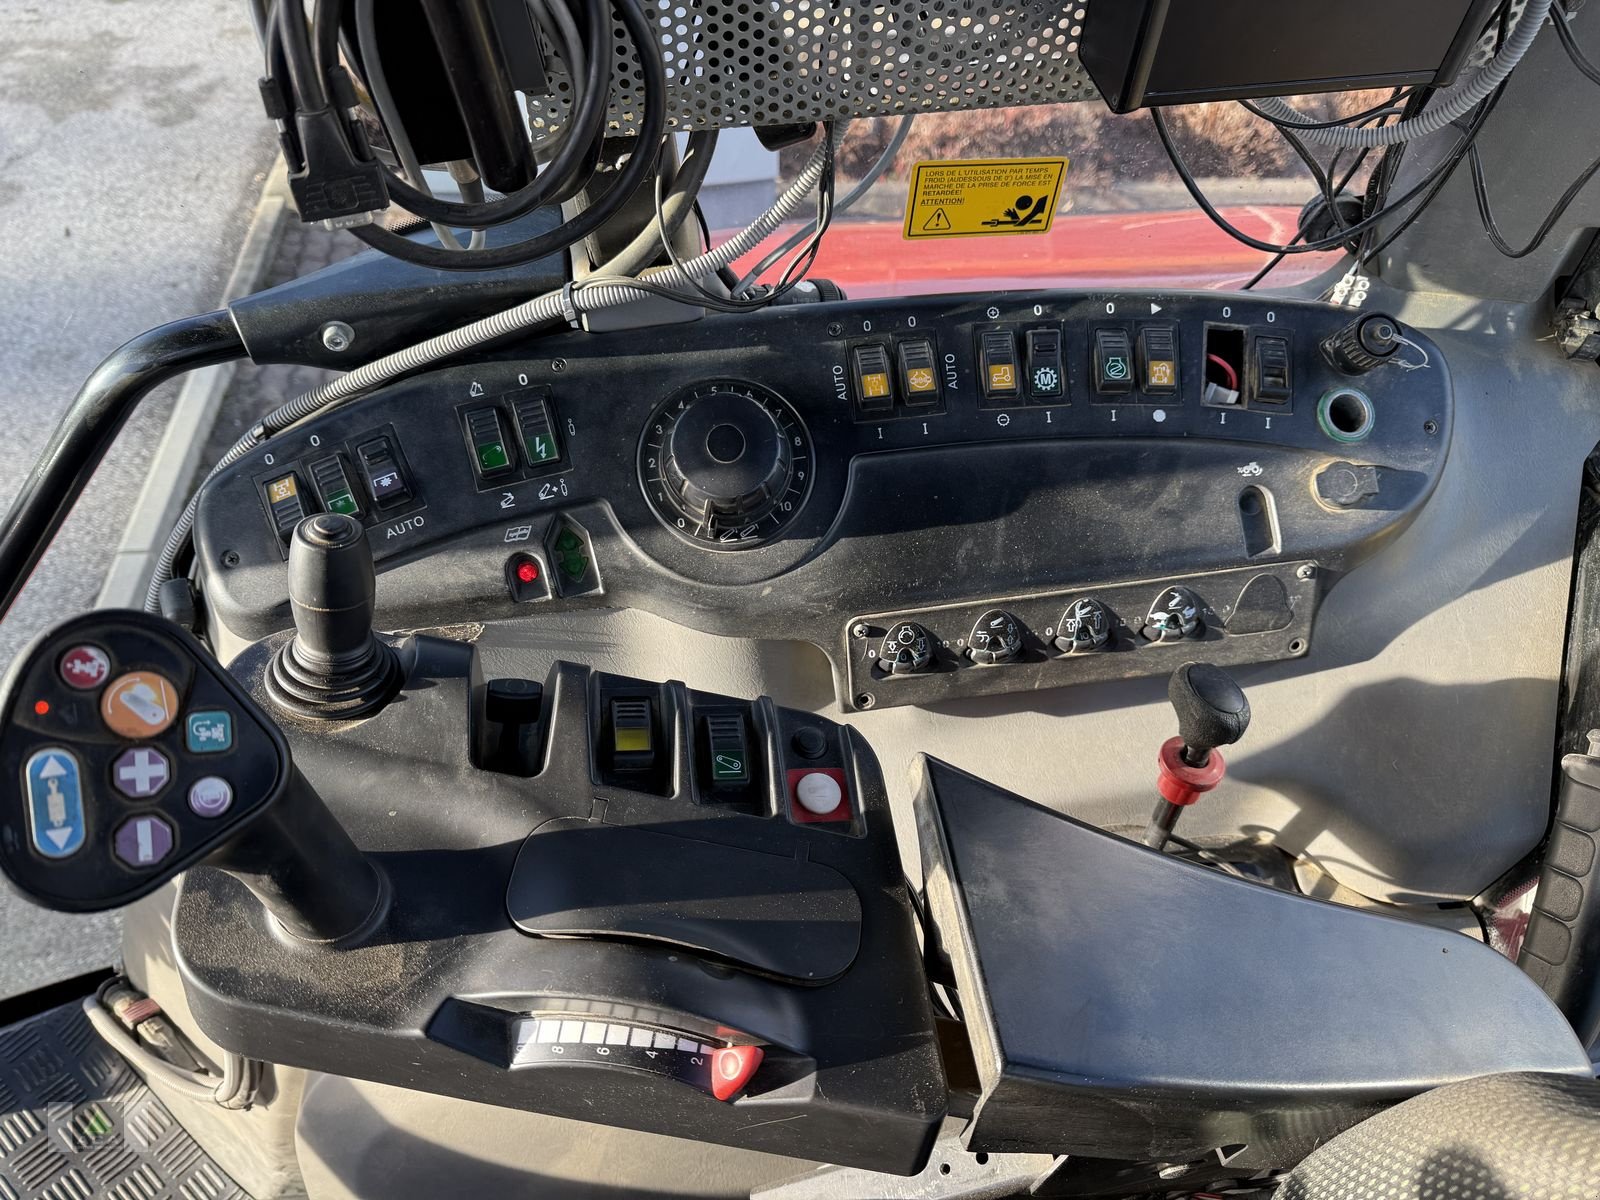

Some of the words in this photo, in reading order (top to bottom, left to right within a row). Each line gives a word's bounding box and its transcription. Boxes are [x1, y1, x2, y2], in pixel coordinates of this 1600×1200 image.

[920, 198, 966, 206] ATTENTION!
[945, 353, 958, 390] AUTO
[832, 365, 847, 400] AUTO
[1040, 374, 1051, 385] M
[711, 386, 718, 396] 5
[677, 401, 685, 409] 4
[655, 425, 663, 435] 3
[794, 437, 802, 446] 8
[648, 458, 656, 468] 2
[797, 471, 805, 481] 9
[658, 492, 663, 502] 1
[779, 501, 792, 512] 10
[386, 515, 426, 540] AUTO
[677, 518, 685, 528] 0
[551, 1045, 564, 1055] 8
[596, 1046, 610, 1056] 6
[646, 1049, 659, 1060] 4
[690, 1056, 704, 1066] 2
